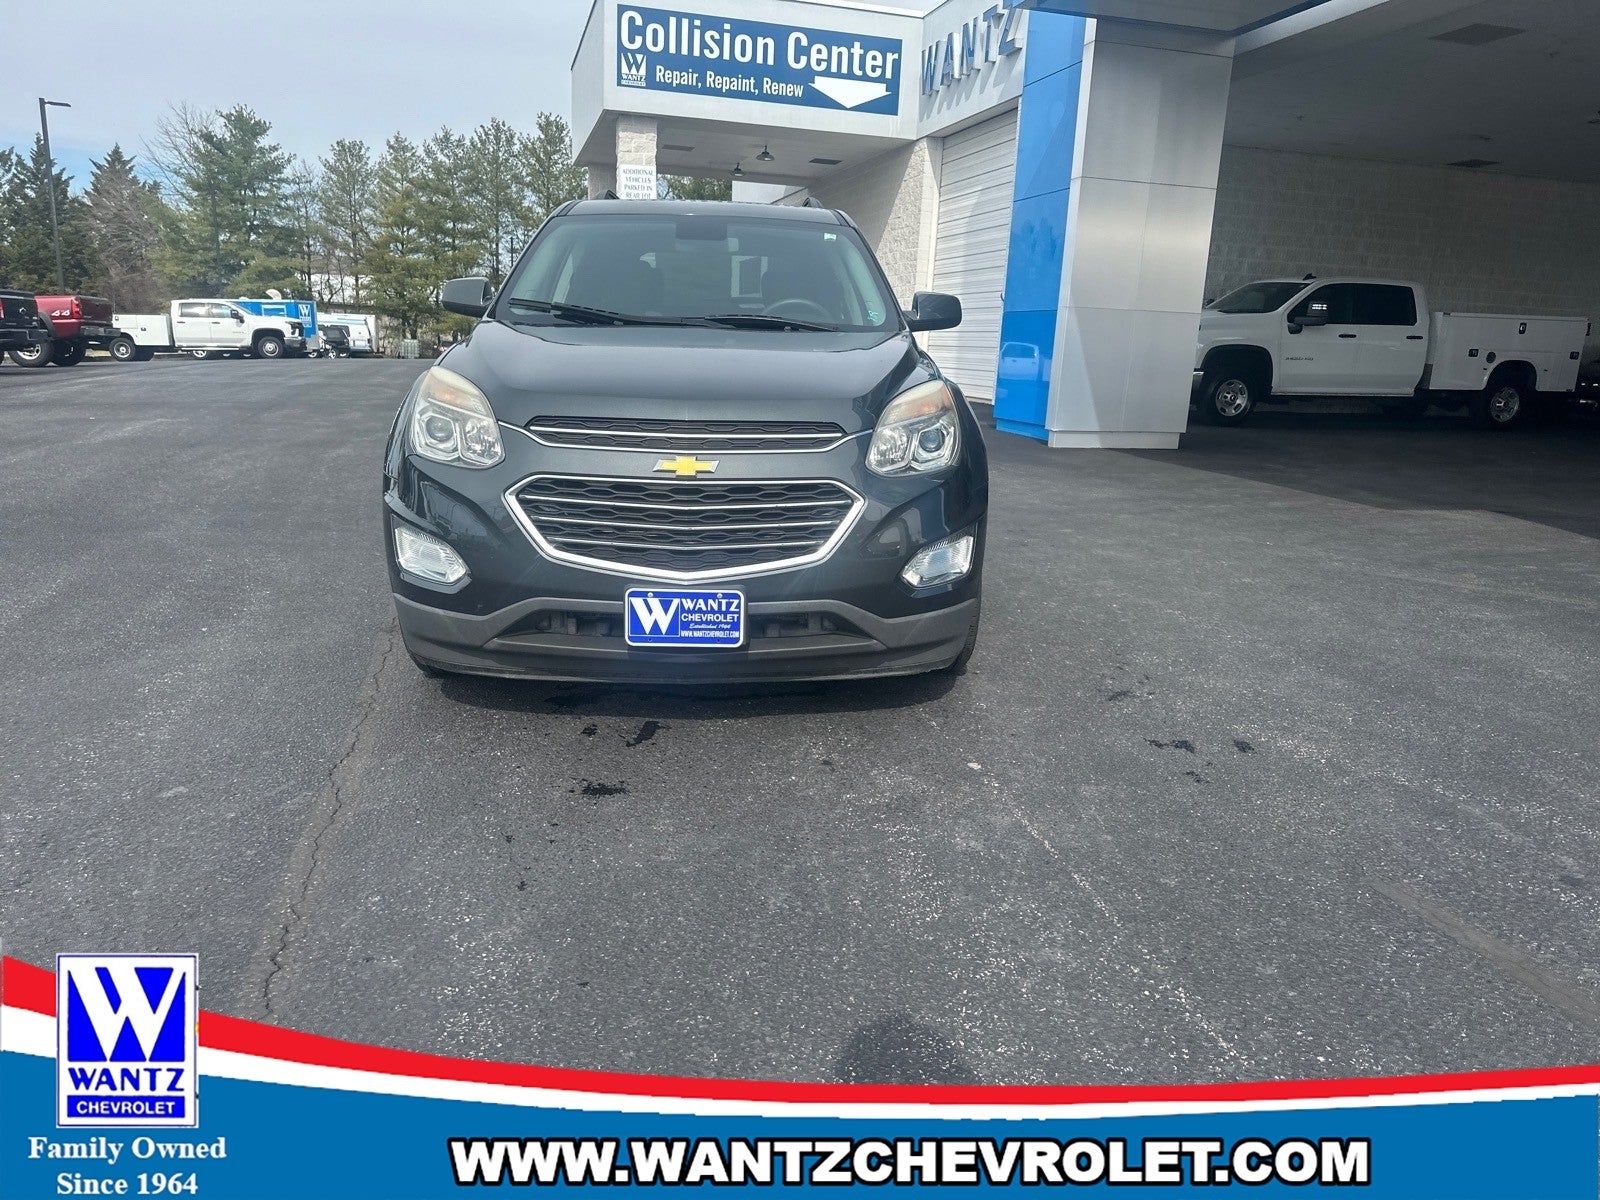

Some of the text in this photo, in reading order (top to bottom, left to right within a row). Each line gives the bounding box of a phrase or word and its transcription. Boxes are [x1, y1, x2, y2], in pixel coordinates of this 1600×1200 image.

[620, 10, 899, 79] Collision Center
[921, 2, 1023, 96] WANTZ
[621, 73, 646, 82] WANTZ
[656, 65, 804, 98] Repair, Repaint, Renew
[623, 168, 653, 176] ADDITIONAL
[51, 309, 71, 317] 44
[681, 598, 740, 611] WANTZ
[629, 597, 680, 635] W
[681, 613, 739, 622] CHEVROLET
